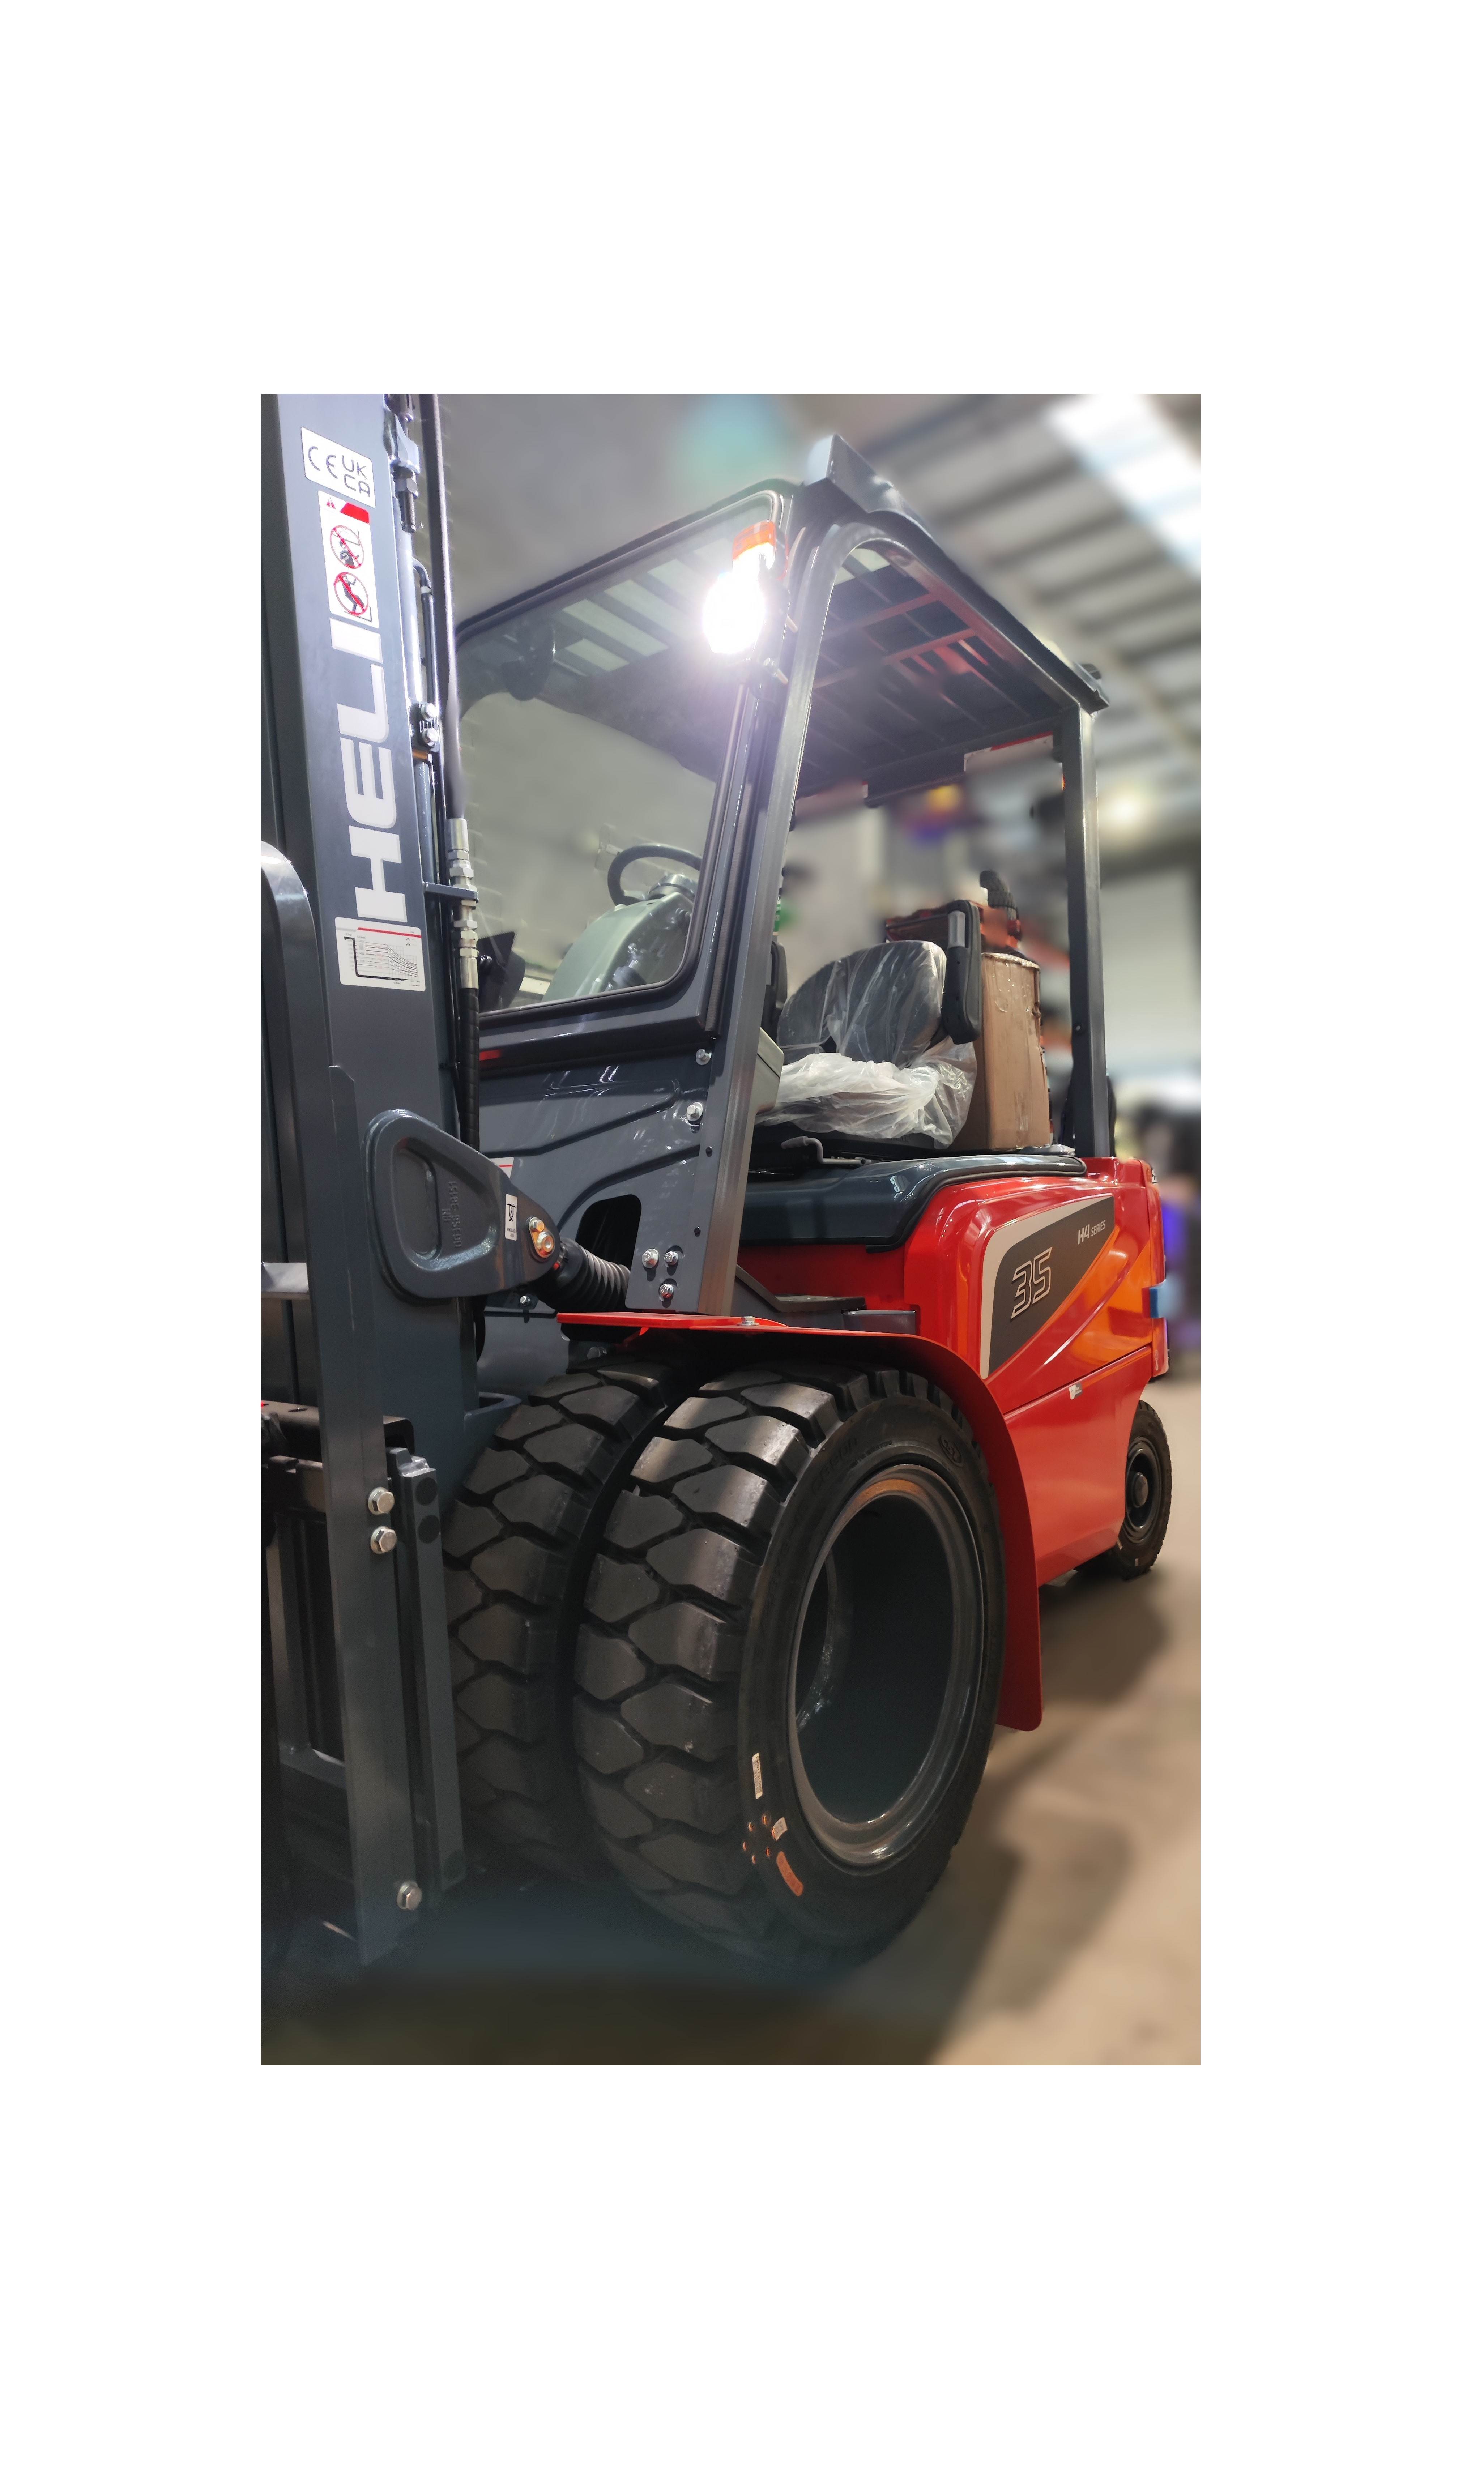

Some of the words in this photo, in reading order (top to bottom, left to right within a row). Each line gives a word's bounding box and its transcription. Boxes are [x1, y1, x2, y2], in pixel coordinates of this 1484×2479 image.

[308, 446, 338, 479] CE
[341, 455, 367, 480] UK
[344, 474, 371, 498] CA
[329, 617, 408, 922] HELI
[1078, 1224, 1090, 1245] H4
[1091, 1220, 1106, 1237] SERIES
[1011, 1246, 1053, 1320] 35
